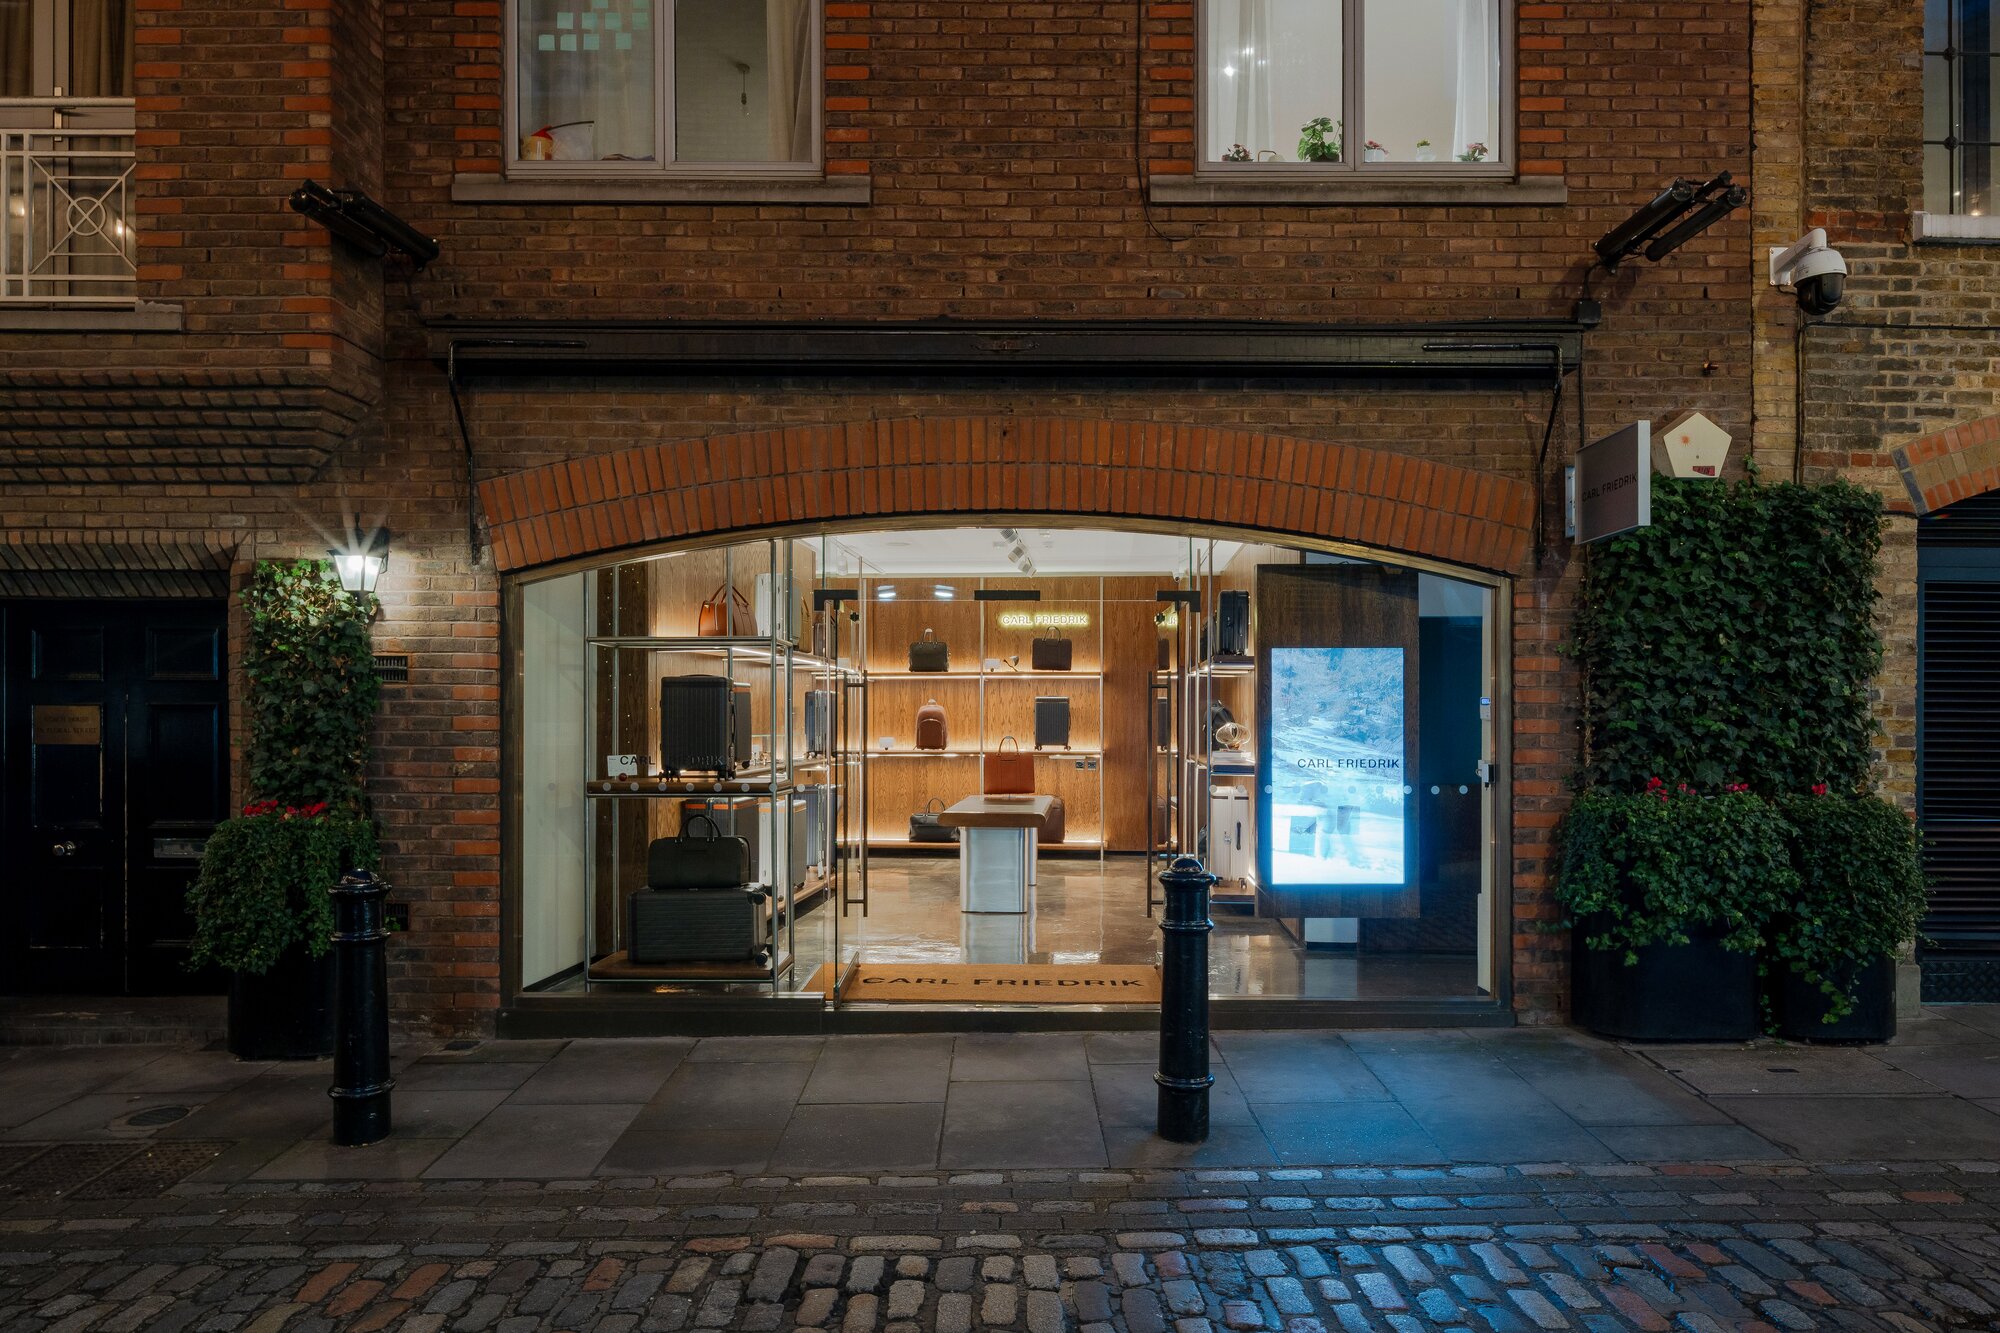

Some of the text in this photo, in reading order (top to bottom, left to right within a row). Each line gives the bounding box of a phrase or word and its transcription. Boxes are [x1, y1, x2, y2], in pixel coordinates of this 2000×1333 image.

[1582, 473, 1637, 502] CARL FRIEDRIK
[1002, 615, 1087, 624] CARL FRIEDRIK
[620, 755, 656, 766] CARL
[1297, 758, 1400, 769] CARL FRIEDRIK
[862, 977, 1145, 987] CARL FRIEDRIK
